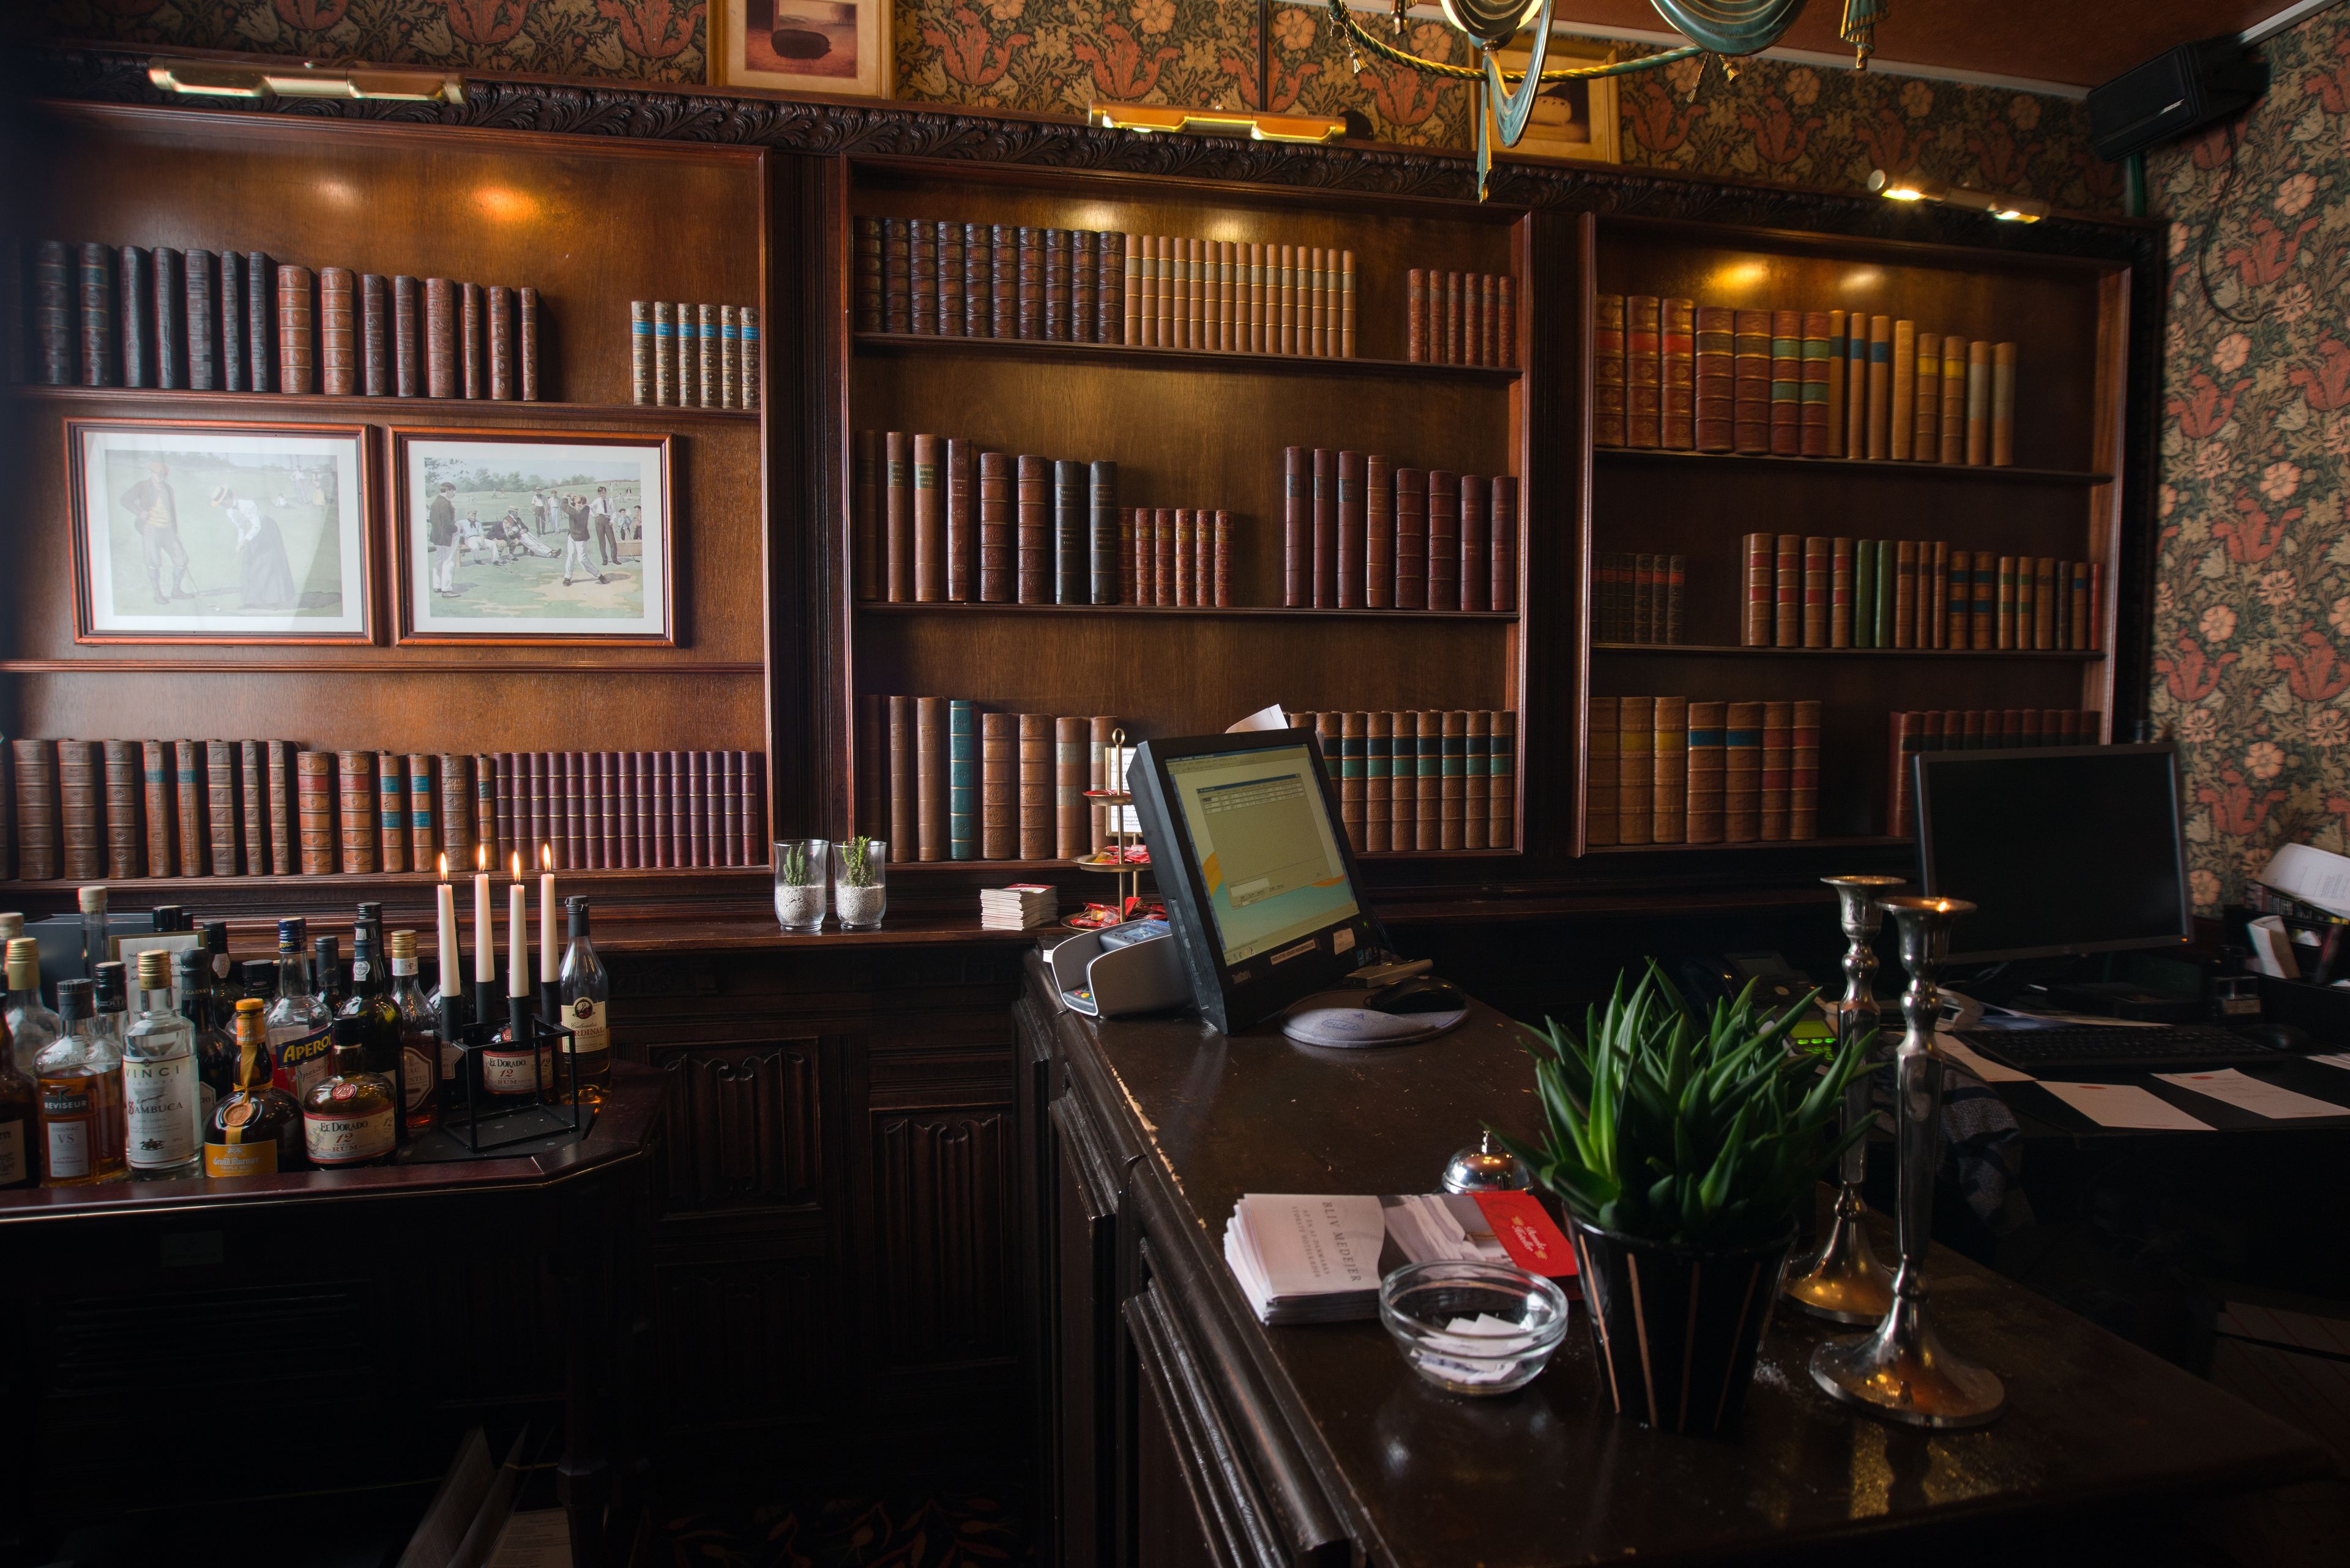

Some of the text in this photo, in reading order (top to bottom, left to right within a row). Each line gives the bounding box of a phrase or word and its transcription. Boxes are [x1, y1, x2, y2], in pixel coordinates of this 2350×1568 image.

[575, 1026, 605, 1037] RDINAL
[283, 1033, 332, 1063] APEROL
[498, 1059, 526, 1068] DORADO
[125, 1066, 179, 1078] VINCI
[500, 1069, 515, 1078] 12
[44, 1100, 88, 1110] REVISEUR
[127, 1101, 184, 1115] SAMBUCA
[321, 1120, 368, 1132] EL DORADO
[383, 1116, 394, 1127] 12
[58, 1134, 74, 1144] VS
[336, 1132, 353, 1144] 12
[213, 1156, 260, 1166] Grand Marnier
[1322, 1202, 1362, 1282] BLIV MEDEJER
